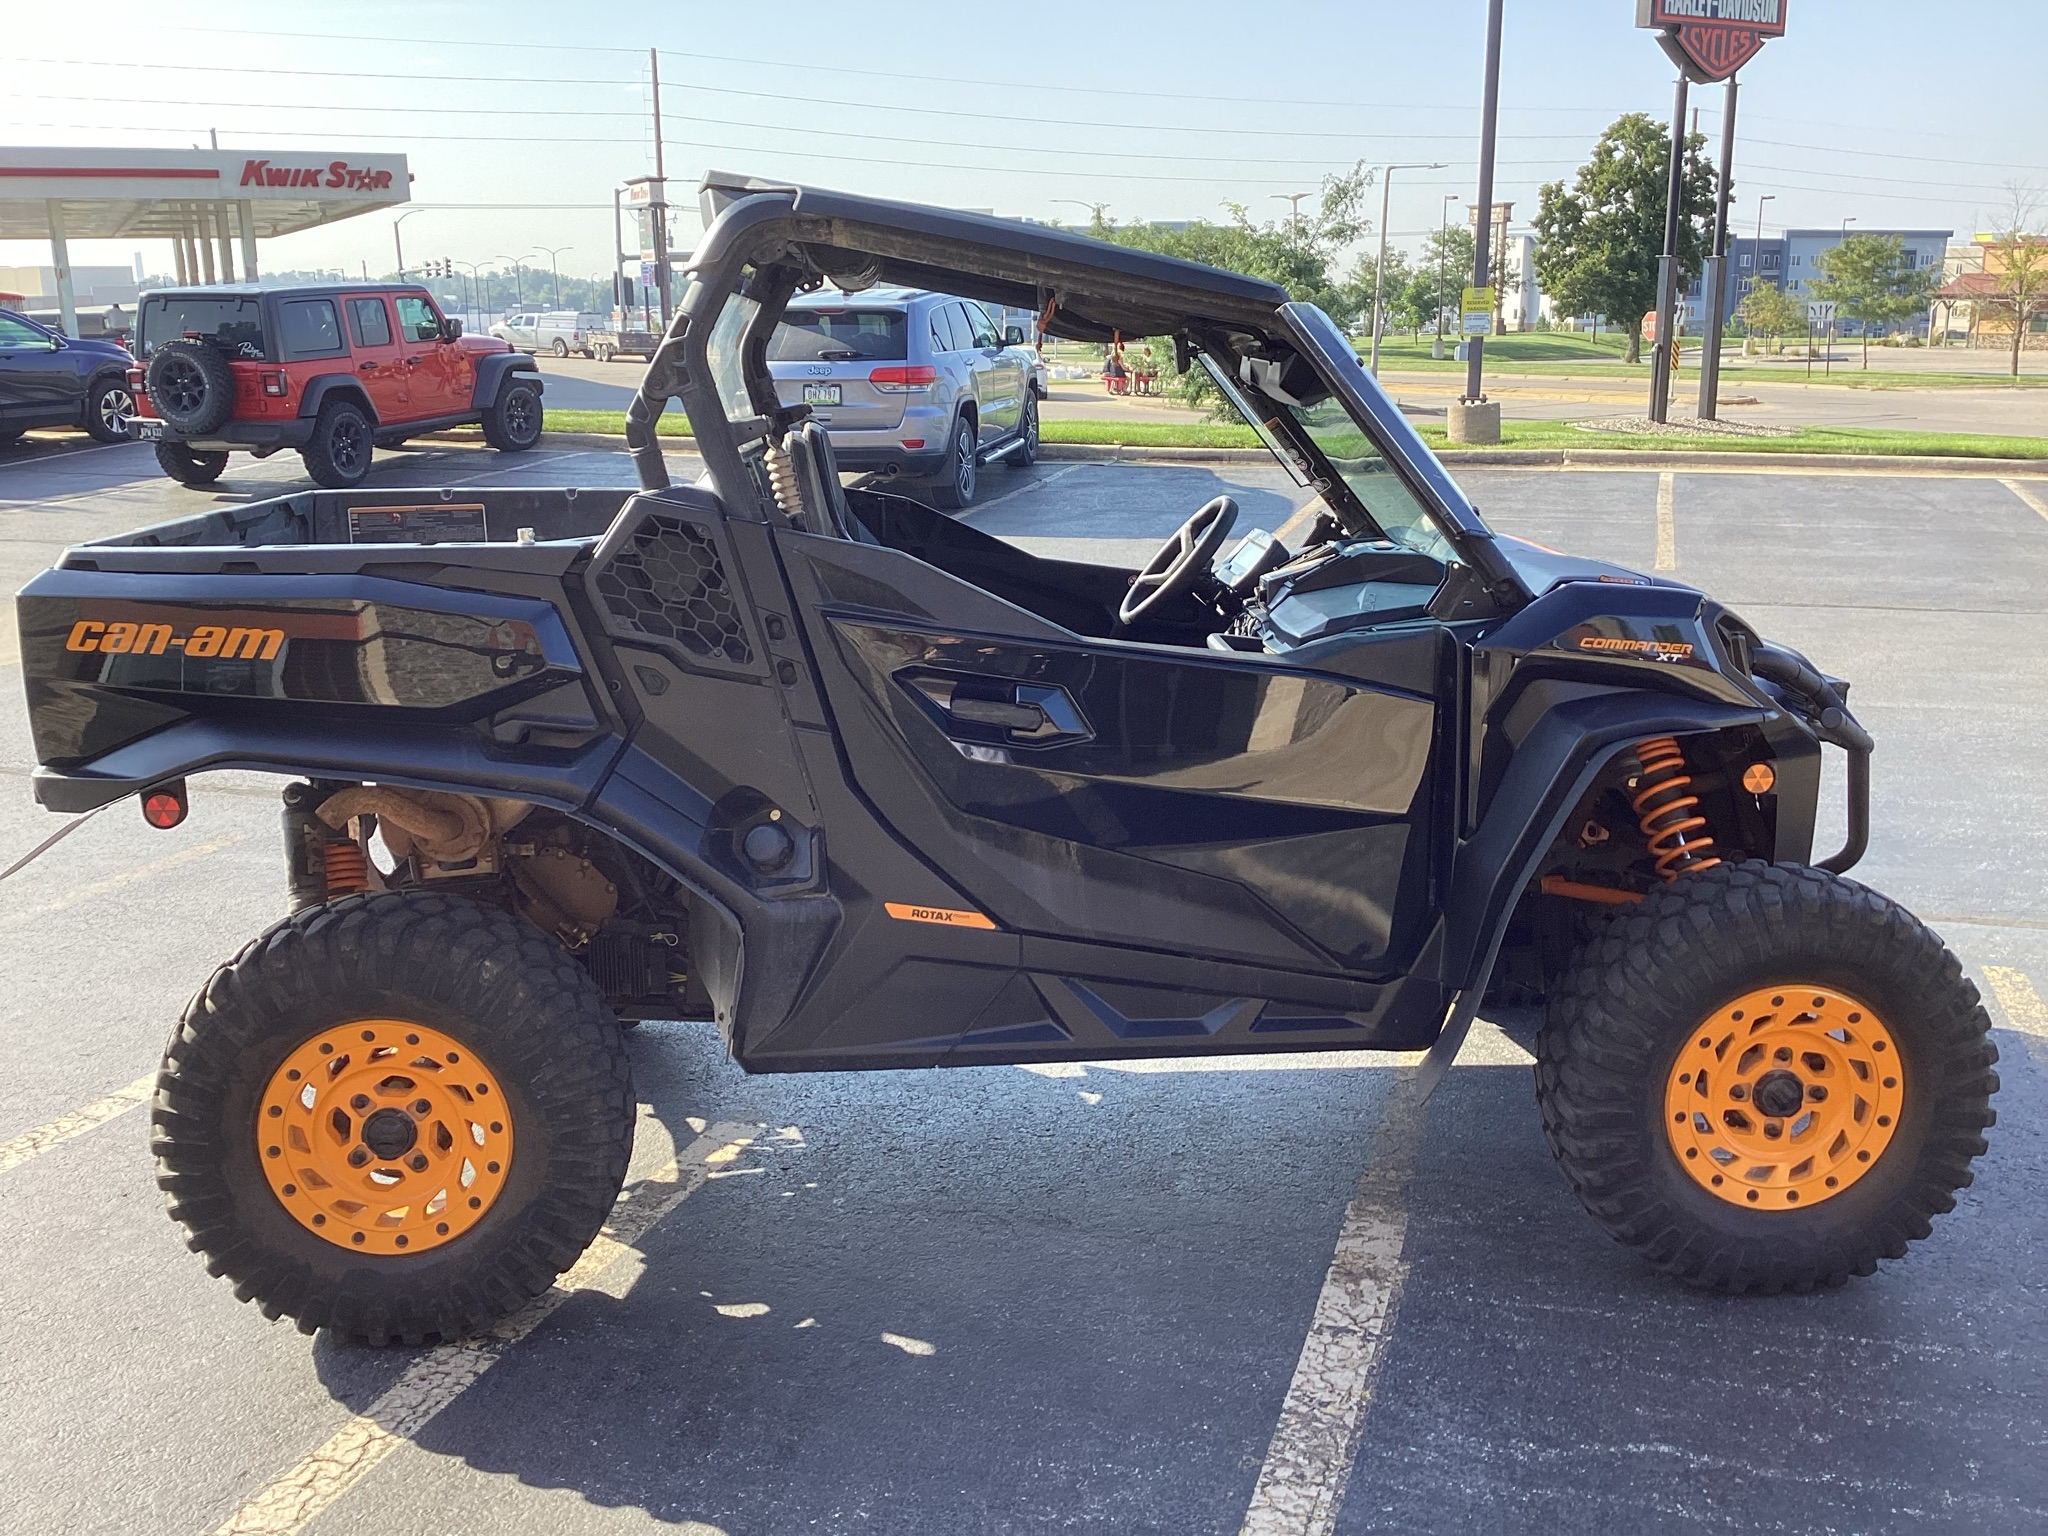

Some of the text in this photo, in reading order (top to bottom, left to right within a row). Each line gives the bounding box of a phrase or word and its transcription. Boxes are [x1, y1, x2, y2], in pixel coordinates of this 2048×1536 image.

[1664, 0, 1778, 23] HARLEY-DAVIDSON
[1690, 26, 1750, 66] CYCLES
[240, 160, 392, 191] KWIK STAR
[808, 366, 832, 376] Jeep
[823, 389, 836, 400] 797
[65, 620, 285, 660] can-am
[1580, 637, 1693, 654] COMMANDER
[911, 908, 953, 922] ROTAX
